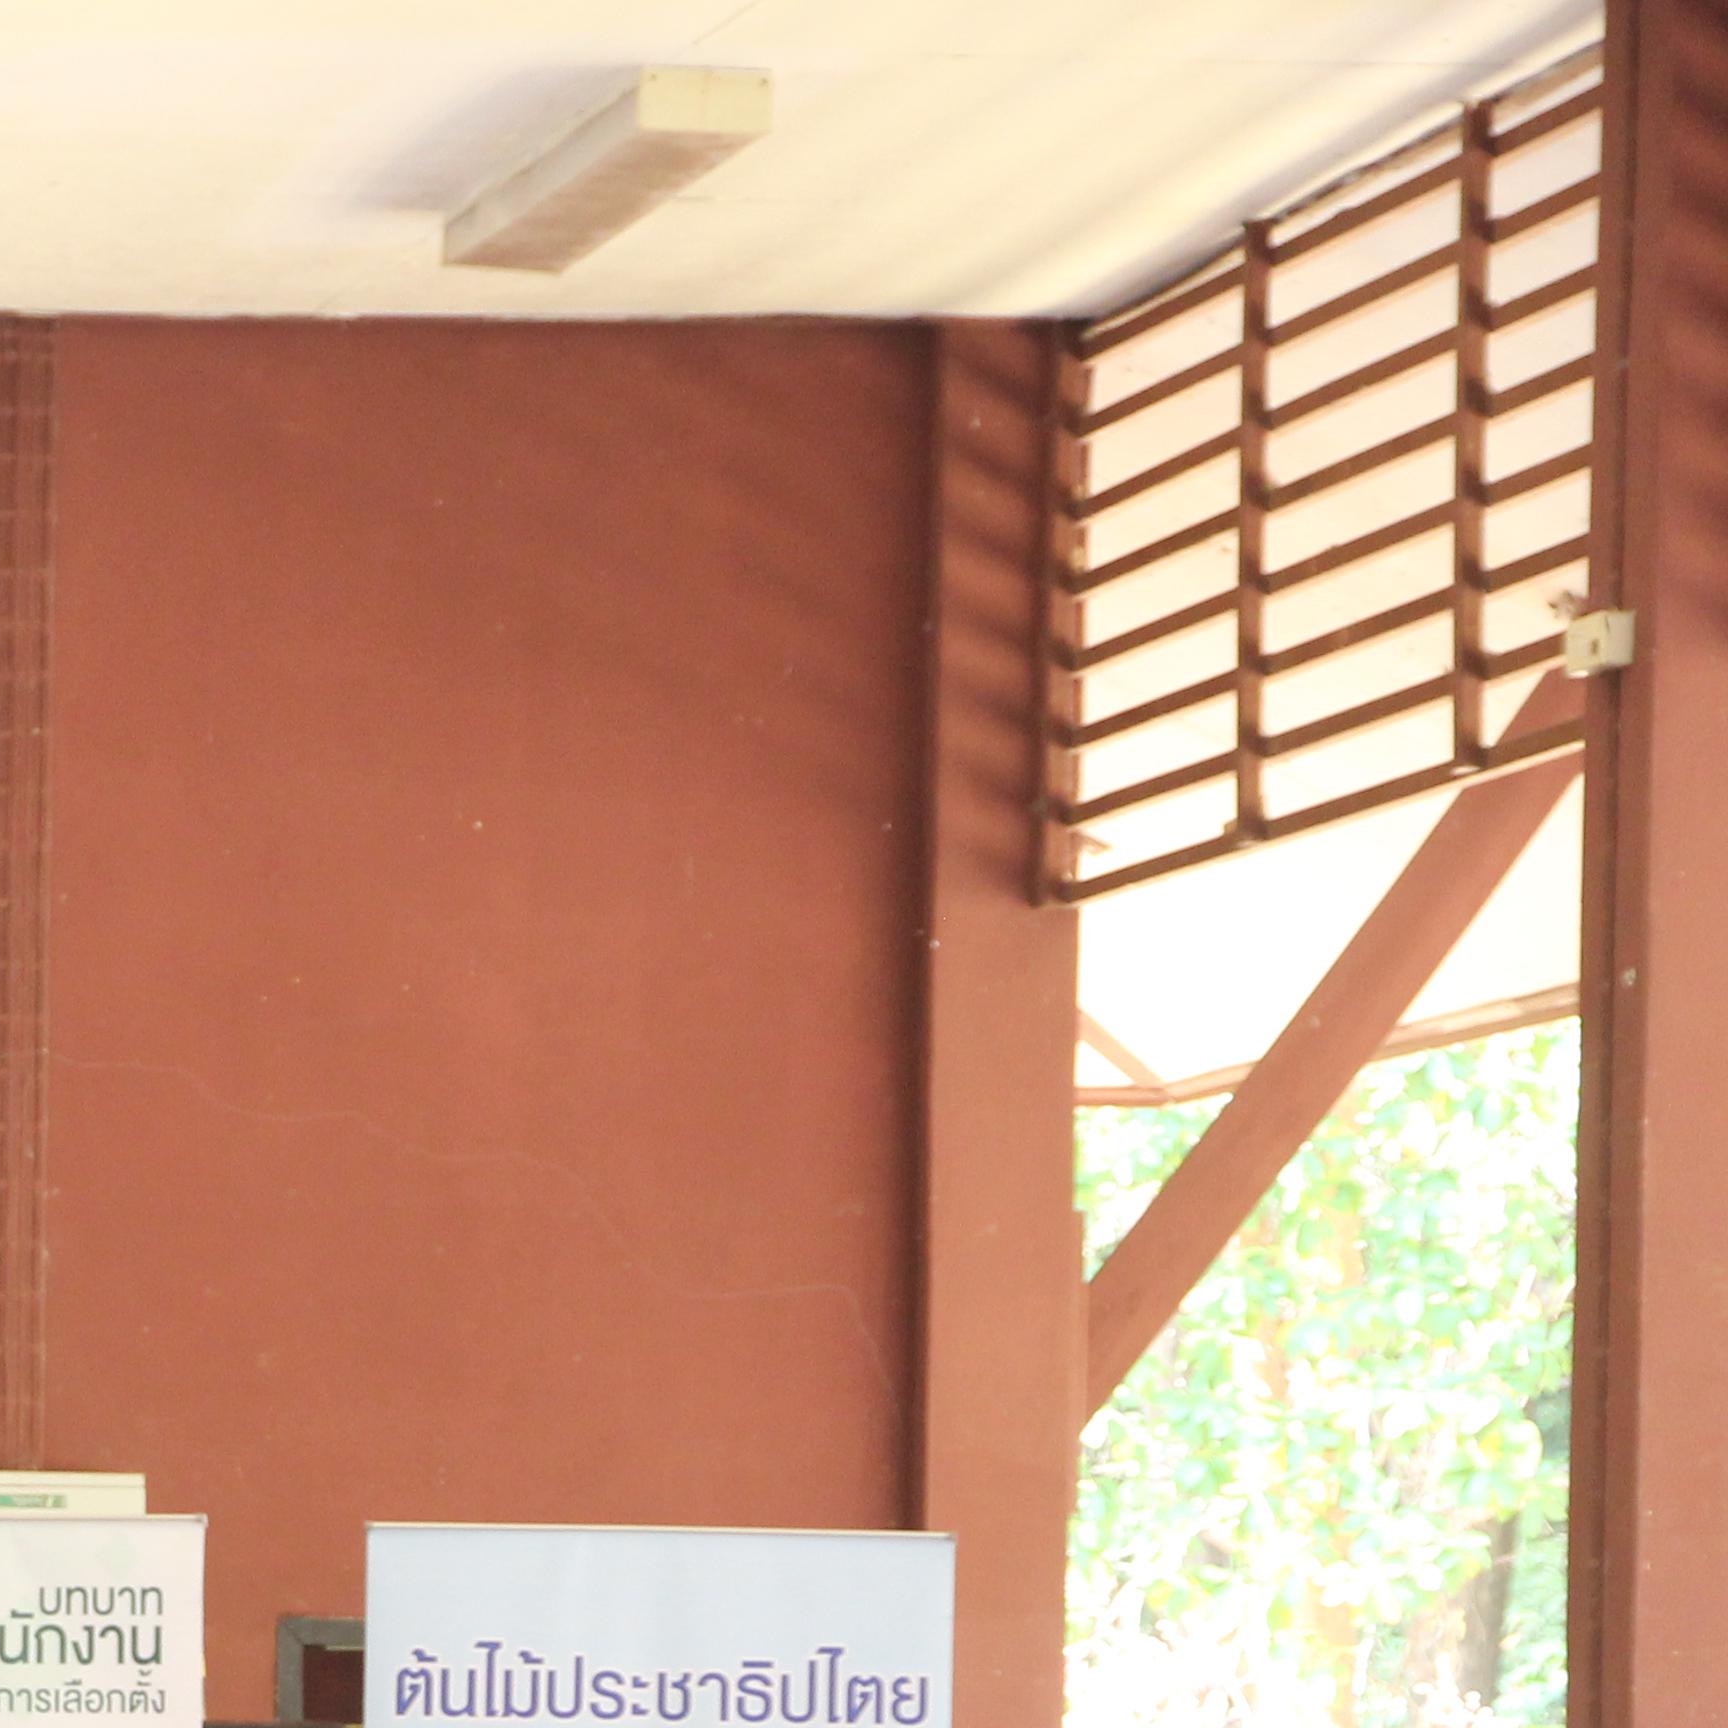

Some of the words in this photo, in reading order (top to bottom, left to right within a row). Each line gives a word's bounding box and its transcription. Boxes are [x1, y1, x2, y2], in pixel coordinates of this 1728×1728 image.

[38, 1584, 163, 1616] บทบาท
[394, 1639, 929, 1725] ต้นไม้ประชาธิปไตย
